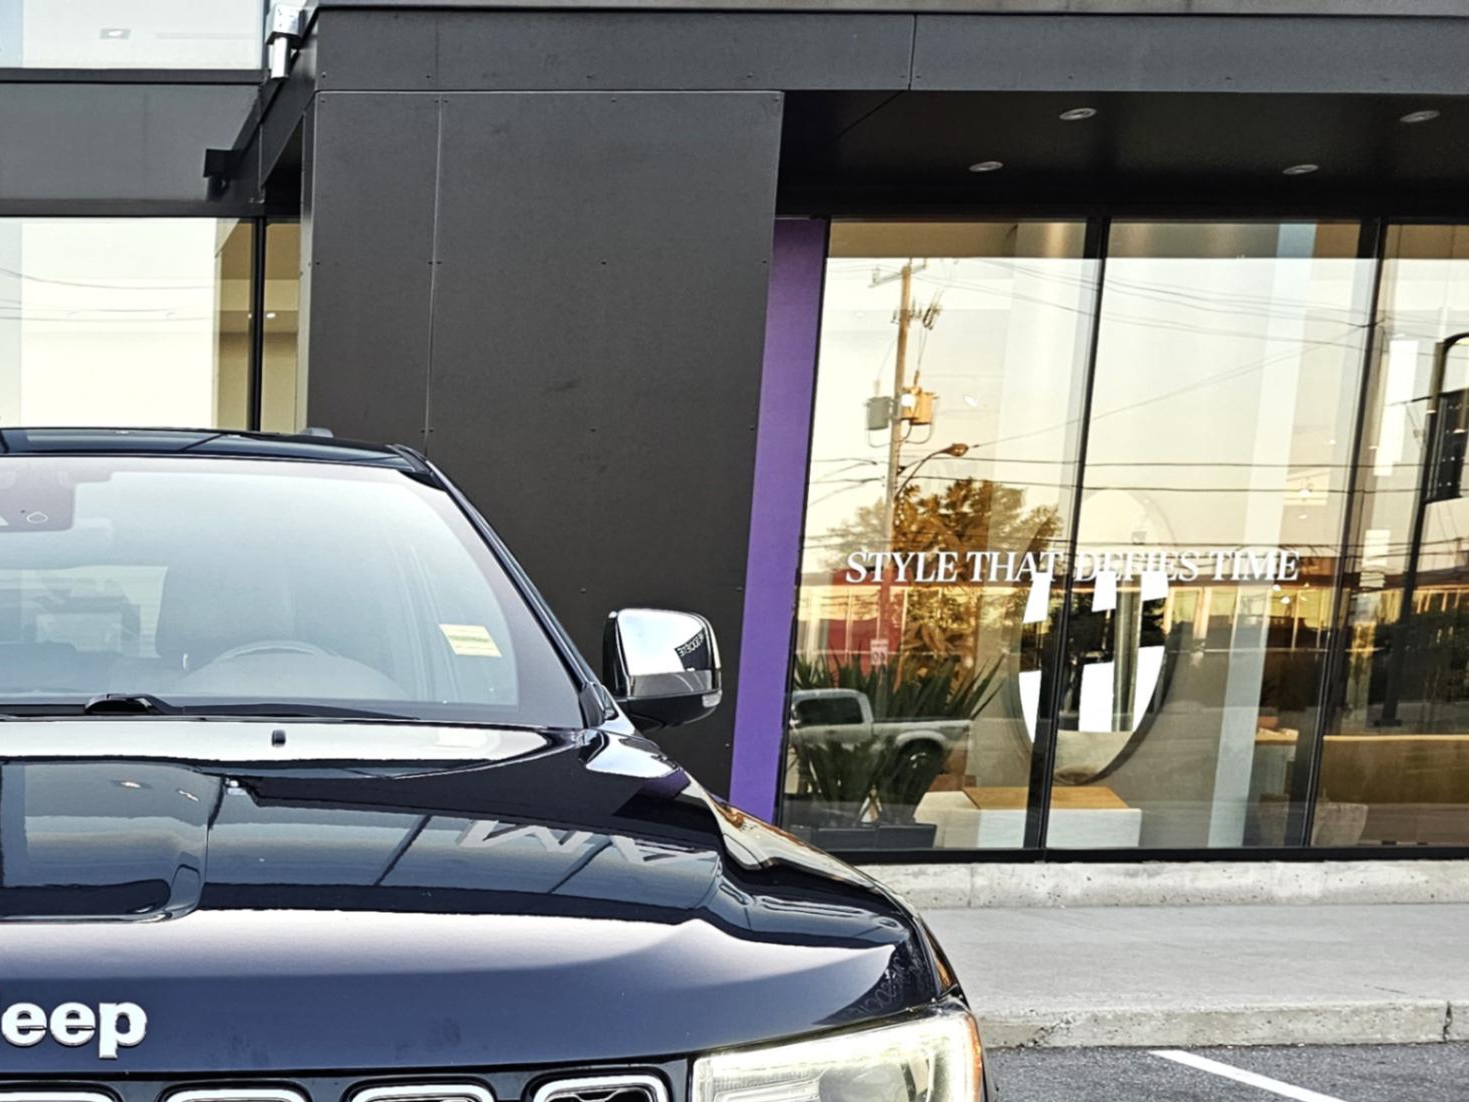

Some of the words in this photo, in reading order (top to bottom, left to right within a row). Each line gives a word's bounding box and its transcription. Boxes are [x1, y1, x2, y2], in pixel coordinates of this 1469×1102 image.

[845, 550, 959, 583] STYLE
[966, 550, 1064, 583] THAT
[1072, 549, 1201, 583] DEFIES
[1209, 549, 1301, 583] TIME
